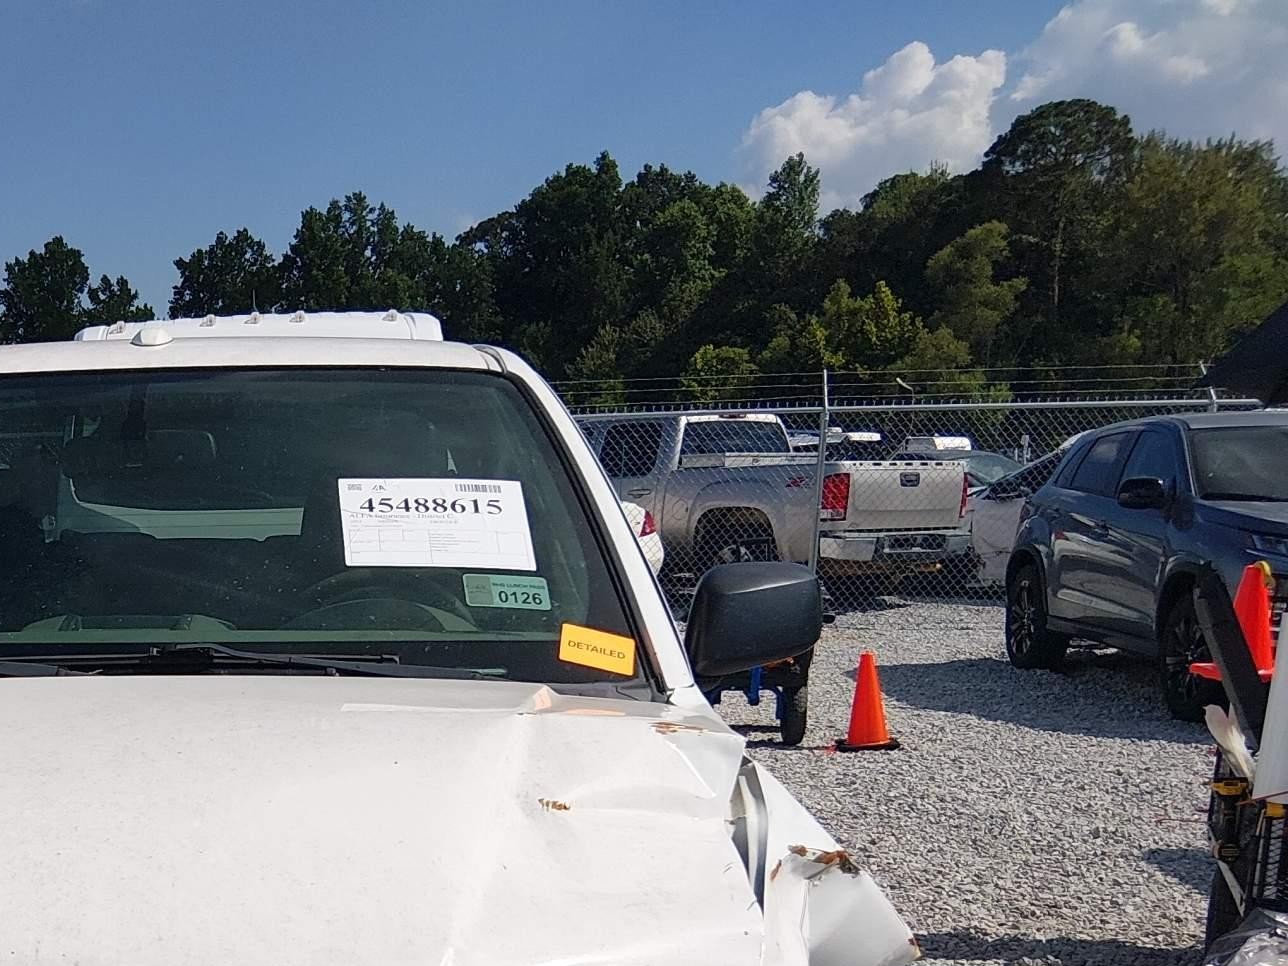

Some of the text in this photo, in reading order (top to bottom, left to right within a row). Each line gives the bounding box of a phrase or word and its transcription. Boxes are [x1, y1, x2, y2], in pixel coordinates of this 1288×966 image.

[359, 496, 503, 516] 45488615
[498, 590, 543, 606] 0126
[567, 639, 626, 660] DETAILED
